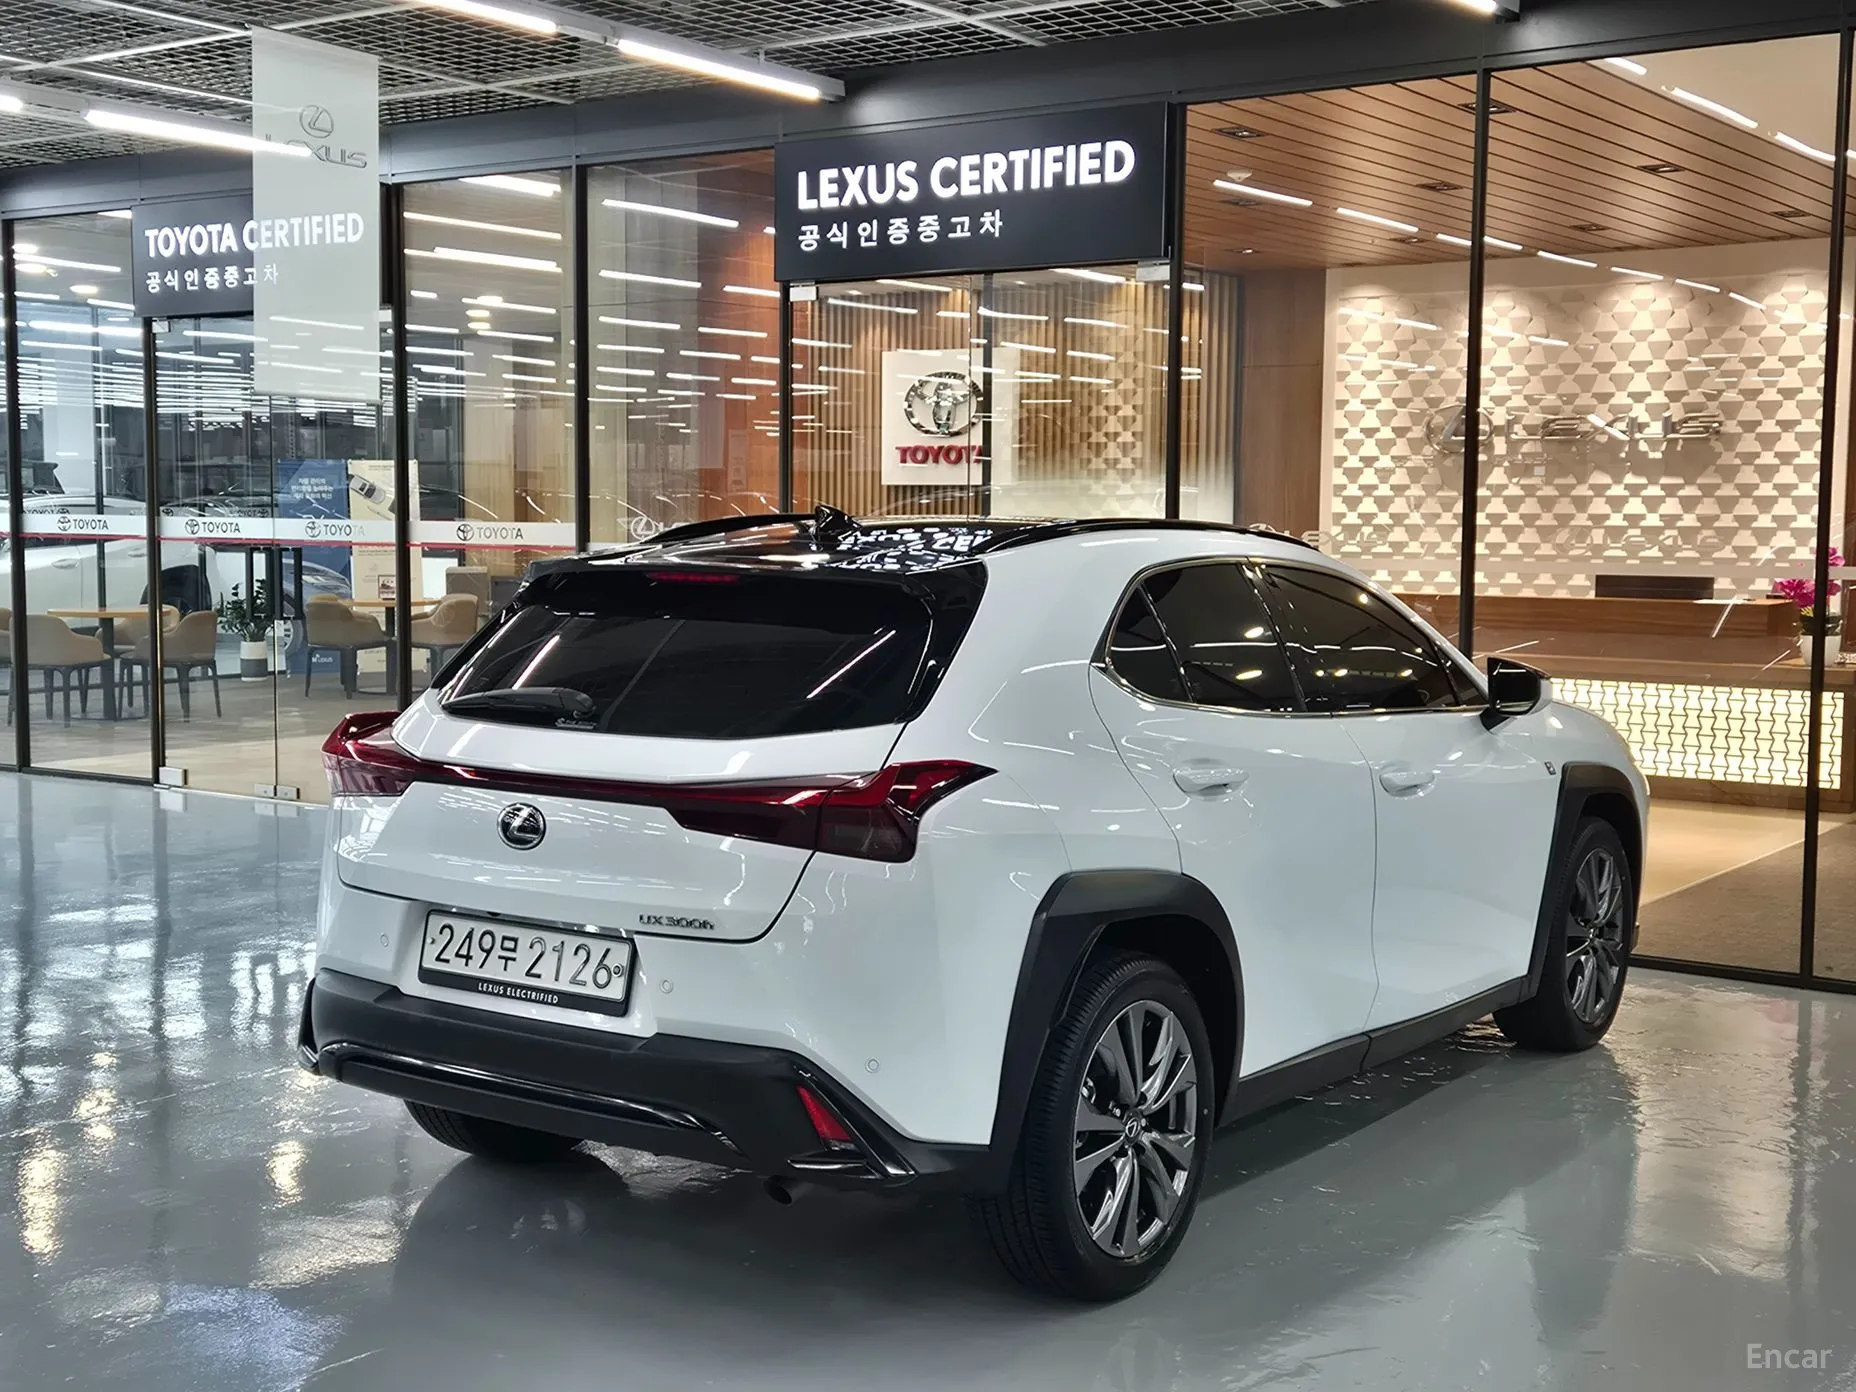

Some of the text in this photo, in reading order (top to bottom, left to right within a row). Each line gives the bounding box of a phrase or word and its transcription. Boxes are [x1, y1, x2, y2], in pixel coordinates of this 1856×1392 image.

[797, 139, 1136, 210] LEXUS CERTIFIED
[144, 212, 364, 258] TOYOTA CERTIFIED
[797, 209, 1003, 252] 공식인증중고차
[145, 263, 278, 293] 공식인증중고차
[1505, 410, 1723, 441] LEXUS
[73, 518, 109, 530] TOYOTA
[202, 521, 241, 533] TOYOTA
[324, 524, 366, 536] TOYOTA
[477, 526, 524, 540] TOYOTA
[478, 982, 559, 1004] LEXUS ELECTRIFIED
